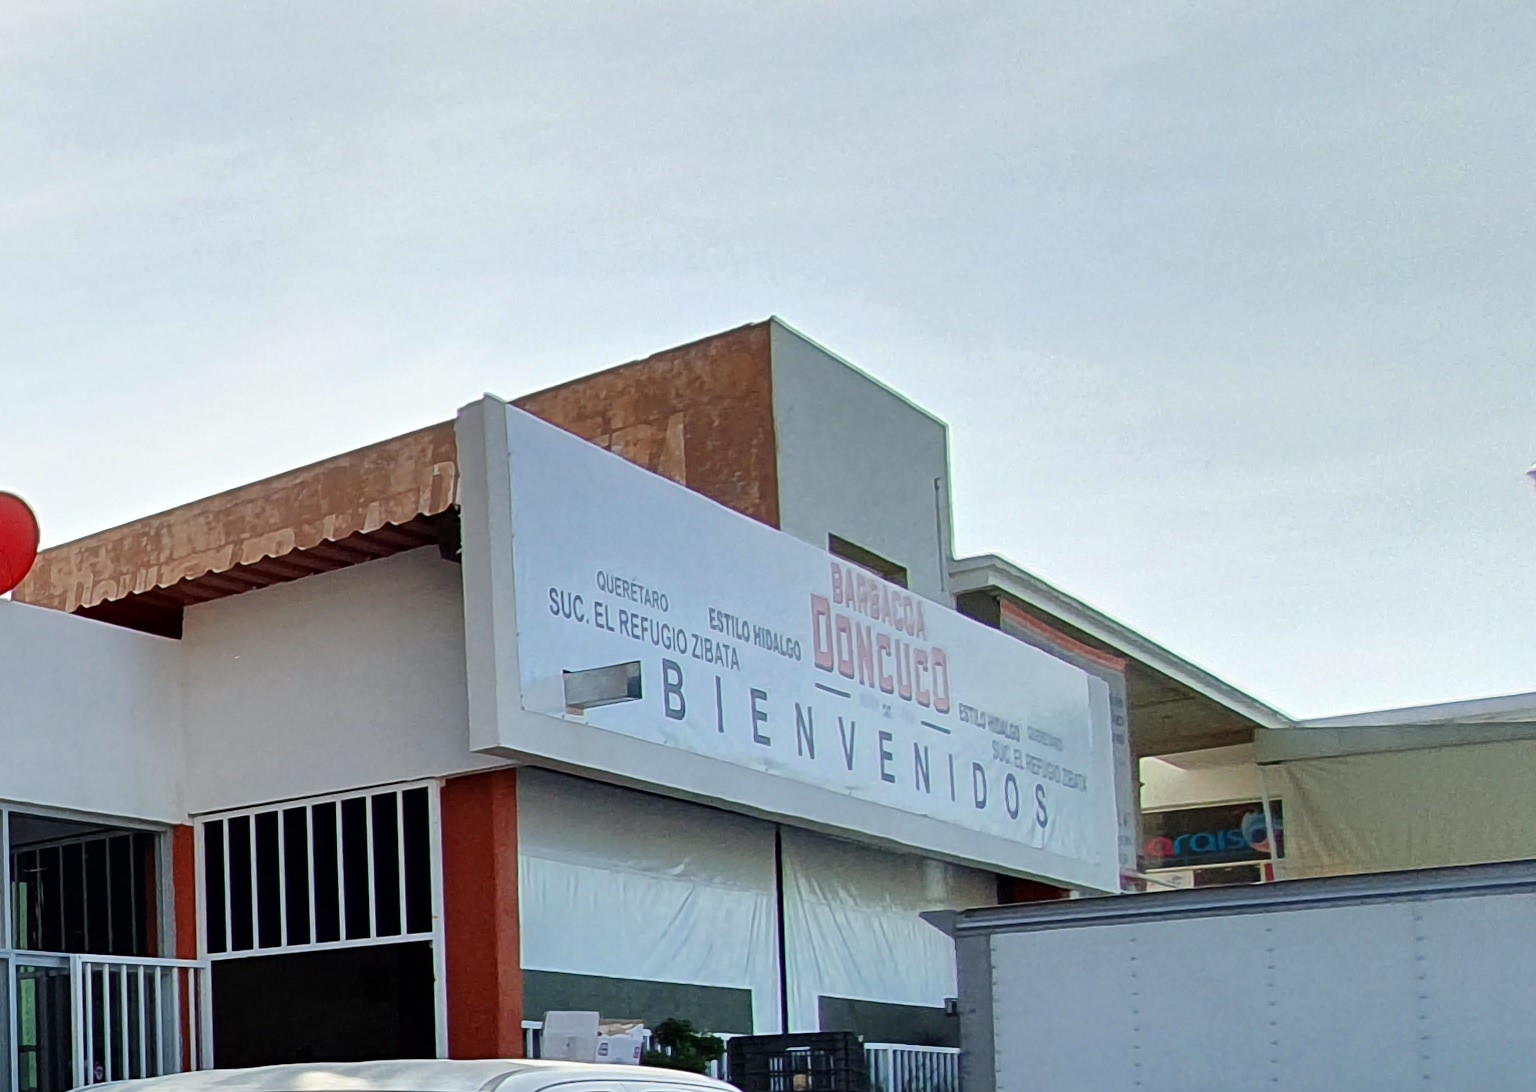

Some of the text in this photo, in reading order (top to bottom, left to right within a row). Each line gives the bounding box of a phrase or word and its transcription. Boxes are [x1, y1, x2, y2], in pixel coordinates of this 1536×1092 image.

[549, 587, 741, 671] SUC. EL REFUGIO ZIBATA
[596, 570, 669, 613] QUERÉTARO
[831, 562, 926, 641] BARBACOA
[708, 608, 802, 661] ESTILO HIDALGO
[662, 657, 1048, 829] BIENVENIDOS
